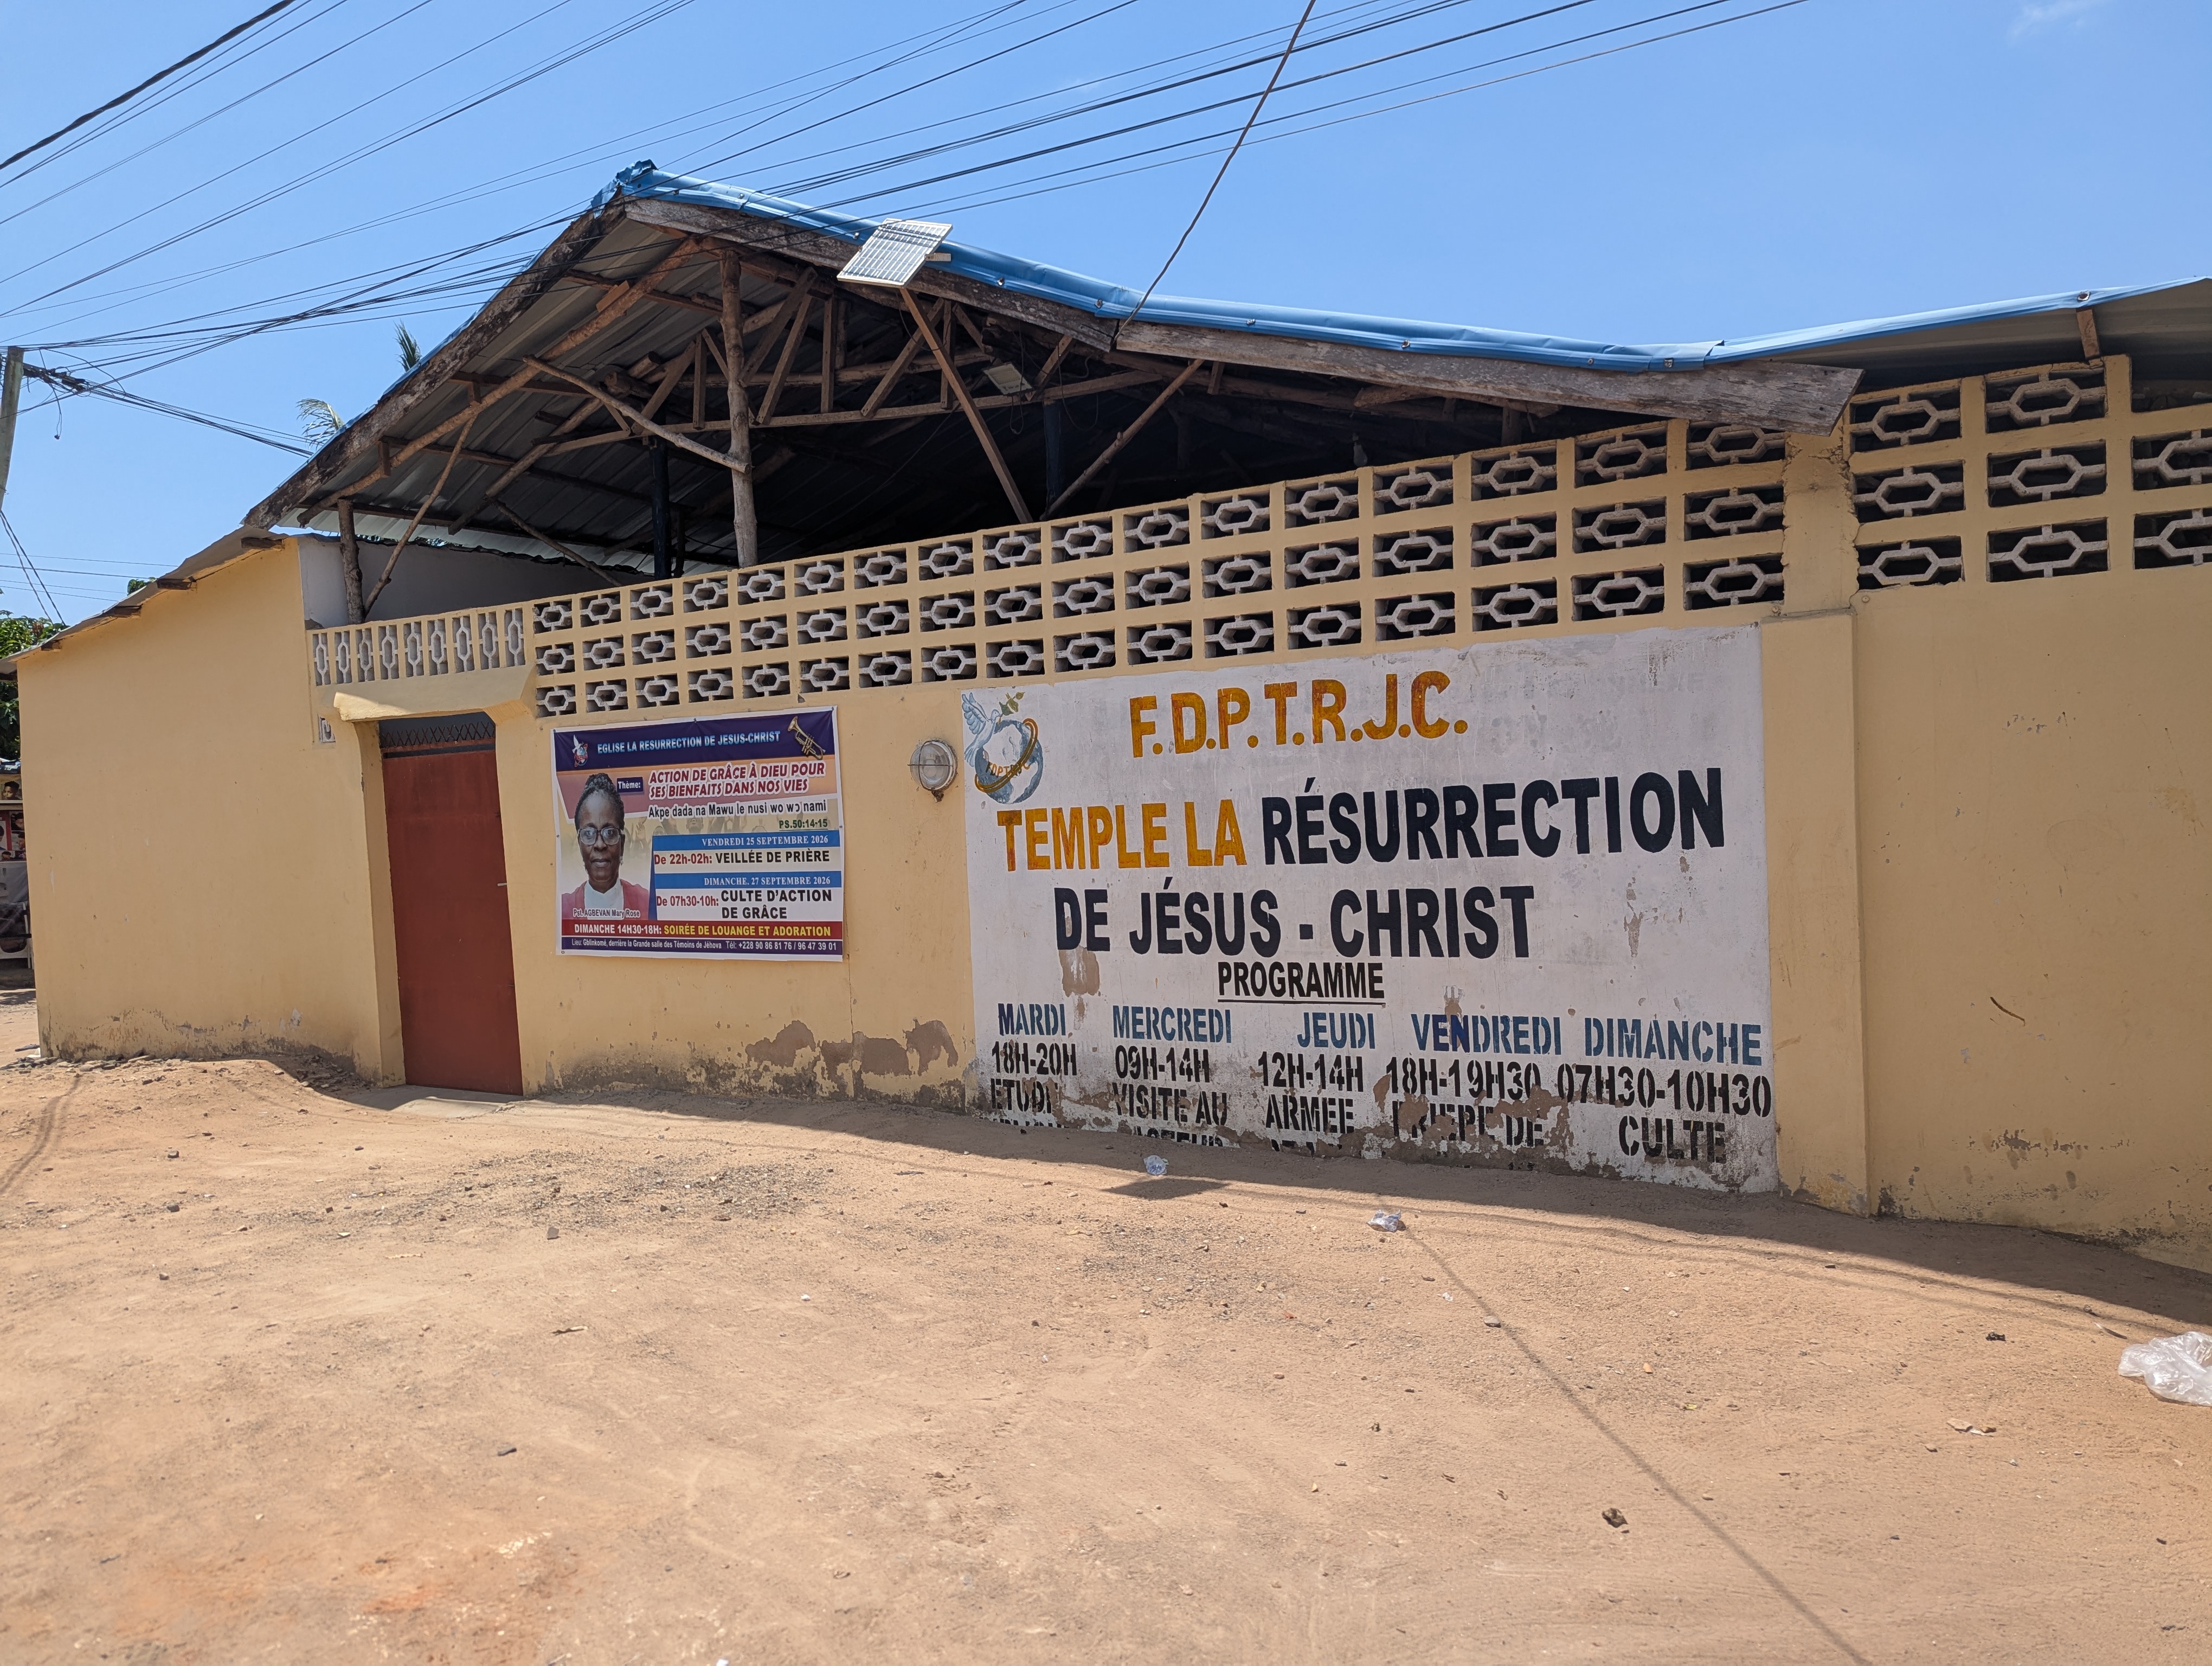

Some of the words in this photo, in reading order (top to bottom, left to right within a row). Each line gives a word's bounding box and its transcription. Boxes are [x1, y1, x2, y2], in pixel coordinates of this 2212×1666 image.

[1130, 670, 1468, 758] F.D.P.T.R.J.C.
[597, 742, 625, 754] EGLISE
[627, 741, 637, 752] LA
[640, 736, 702, 751] RESURRECTION
[704, 735, 715, 746] DE
[718, 731, 780, 745] JESUS-CHRIST
[618, 781, 641, 789] Thème:
[650, 771, 689, 783] ACTION
[692, 770, 706, 781] DE
[710, 764, 746, 780] GRÂCE
[749, 763, 757, 778] À
[761, 765, 787, 777] DIEU
[792, 762, 824, 776] POUR
[651, 786, 665, 798] SES
[668, 783, 721, 797] BIENFAITS
[725, 781, 754, 794] DANS
[758, 780, 780, 793] NOS
[784, 778, 808, 791] VIES
[649, 807, 670, 819] Akpe
[673, 806, 693, 817] dada
[709, 804, 734, 815] Mawu
[737, 803, 744, 814] le
[748, 802, 767, 813] nusi
[770, 804, 783, 813] wo
[803, 799, 826, 811] nami
[779, 819, 827, 829] PS.50:14-15
[996, 802, 1170, 872] TEMPLE
[1185, 799, 1248, 867] LA
[1261, 767, 1724, 864] RÉSURRECTION
[654, 854, 666, 864] De
[670, 853, 712, 864] 22h-02h:
[716, 850, 762, 863] VEILLÉE
[767, 851, 781, 862] DE
[786, 848, 829, 862] PRIÈRE
[702, 838, 744, 846] VENDREDI
[747, 837, 755, 845] 25
[757, 836, 808, 845] SEPTEMBRE
[811, 835, 828, 843] 2026
[657, 896, 667, 906] De
[670, 895, 719, 906] 07h30-10h:
[721, 890, 762, 902] CULTE
[704, 877, 749, 886] DIMANCHE.
[761, 876, 811, 885] SEPTEMBRE
[813, 876, 831, 885] 2026
[612, 909, 624, 918] Mary
[722, 907, 738, 919] DE
[742, 904, 787, 919] GRÂCE
[1054, 887, 1111, 953] DE
[1129, 876, 1282, 958] JÉSUS
[1330, 886, 1534, 958] CHRIST
[575, 924, 615, 933] DIMANCHE
[618, 925, 661, 934] 14H30-18H:
[664, 923, 695, 935] SOIRÉE
[698, 926, 709, 935] DE
[712, 926, 755, 935] LOUANGE
[758, 926, 770, 935] ET
[773, 926, 831, 936] ADORATION
[765, 941, 773, 950] 86
[808, 942, 816, 950] 47
[1218, 962, 1385, 999] PROGRAMME
[998, 1003, 1066, 1036] MARDI
[1113, 1005, 1231, 1043] MERCREDI
[1297, 1012, 1375, 1049] JEUDI
[1411, 1014, 1561, 1055] VENDREDI
[992, 1041, 1077, 1075] 18H-20H
[1585, 1017, 1762, 1066] DIMANCHE
[1115, 1045, 1210, 1083] 09H-14H
[1258, 1051, 1364, 1092] 12H-14H
[1386, 1056, 1541, 1100] 18H-19H30
[1112, 1082, 1188, 1122] VISITE
[1195, 1091, 1227, 1125] AU
[1557, 1063, 1771, 1118] 07H30-10H30
[1265, 1094, 1354, 1134] ARMEE
[1619, 1115, 1726, 1163] CULTE
